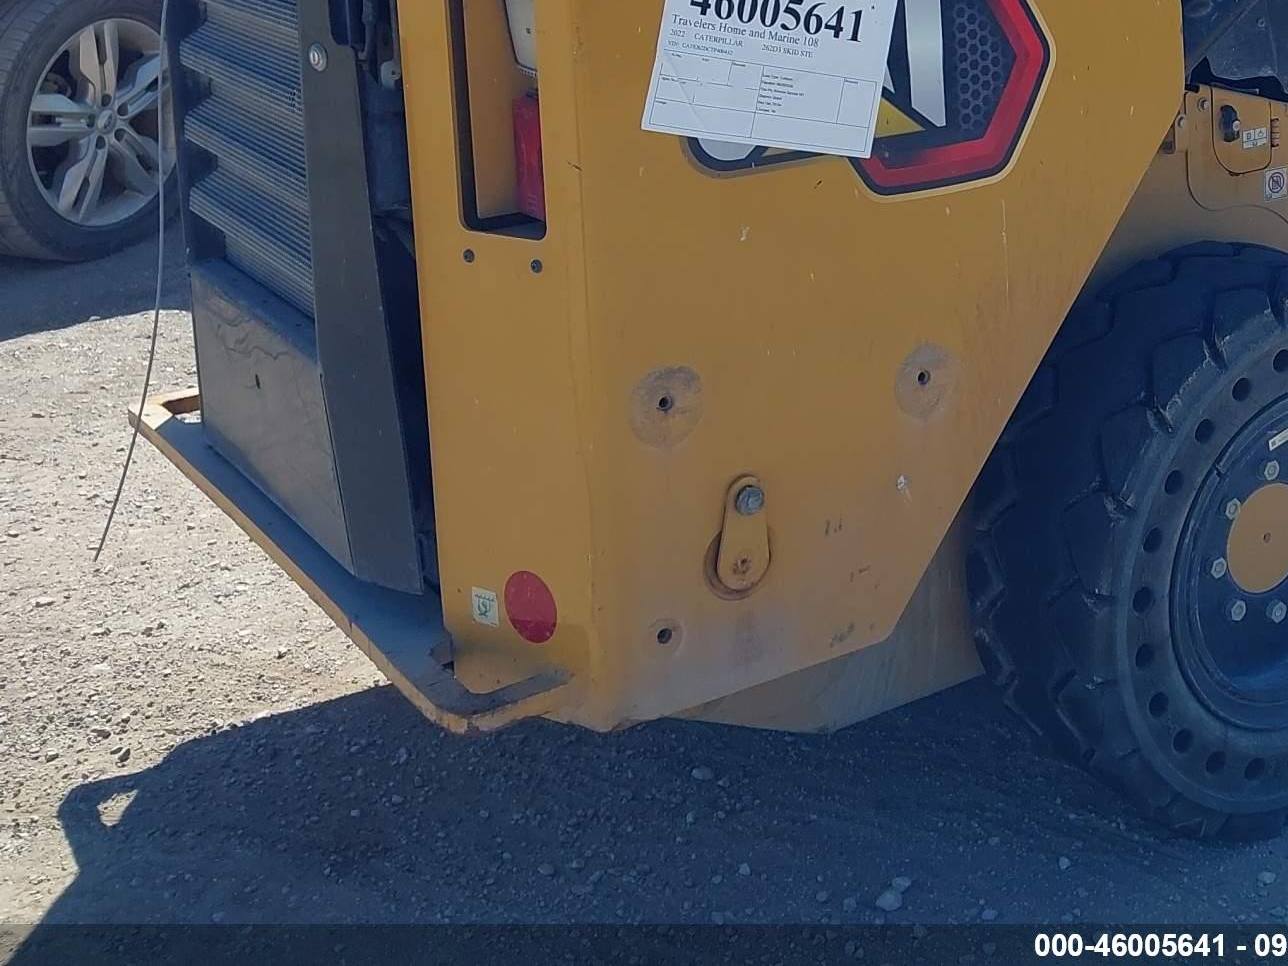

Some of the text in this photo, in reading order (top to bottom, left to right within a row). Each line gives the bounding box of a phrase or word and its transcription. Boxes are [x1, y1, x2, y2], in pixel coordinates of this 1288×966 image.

[672, 14, 819, 48] Travelers Home and Marine 108
[694, 33, 744, 48] CATERPILLAR
